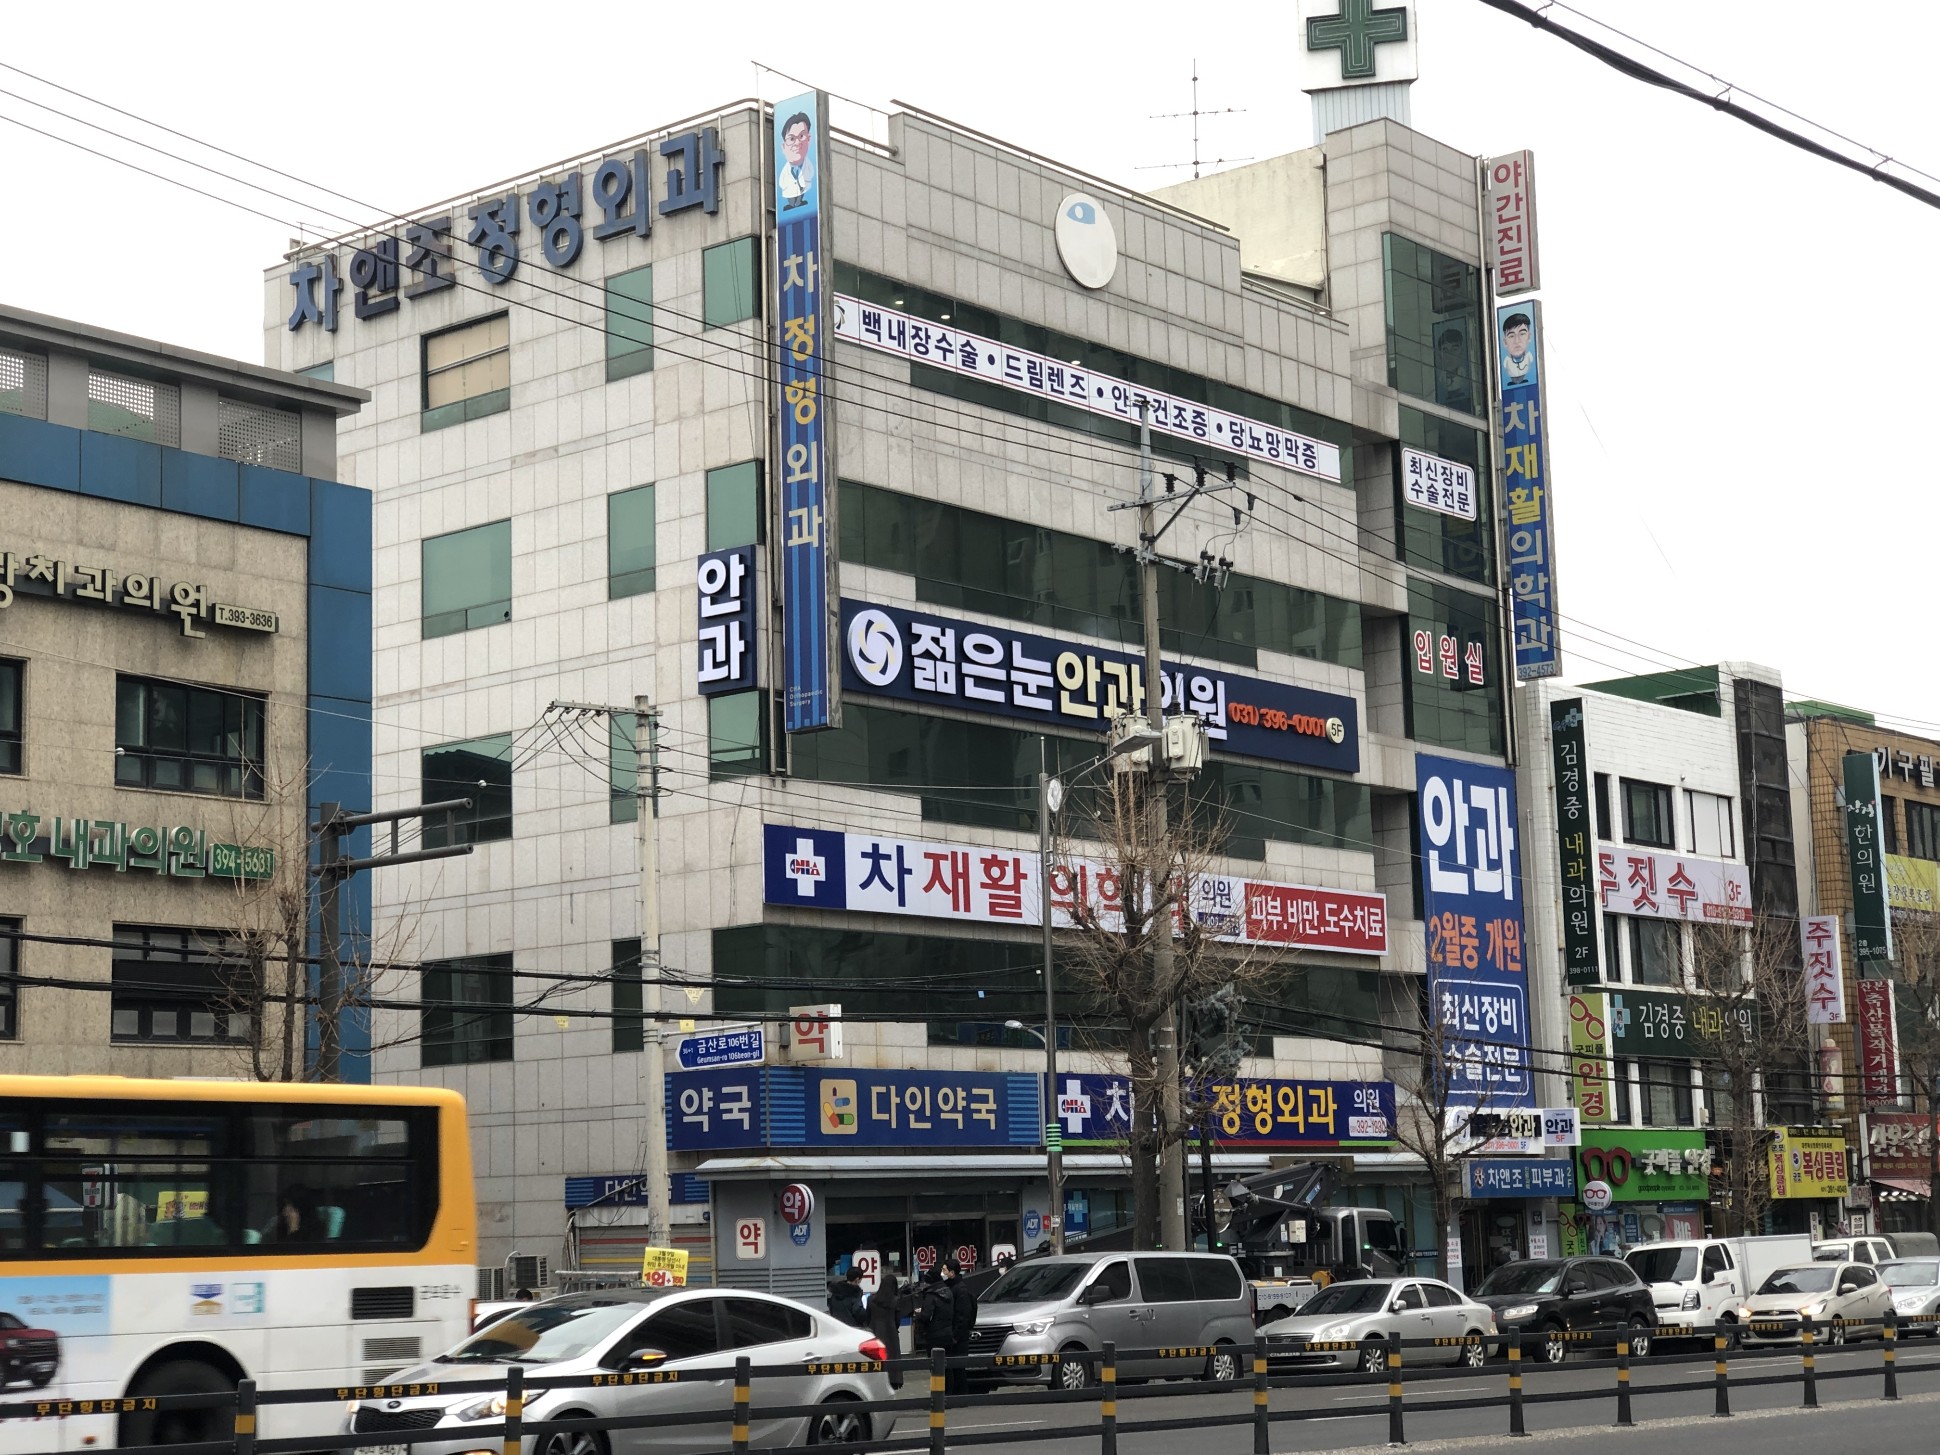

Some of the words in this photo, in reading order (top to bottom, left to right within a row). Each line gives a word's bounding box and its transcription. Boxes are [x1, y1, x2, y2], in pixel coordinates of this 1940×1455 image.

[1494, 160, 1525, 289] 야간진료
[783, 249, 824, 548] 차정형외과
[1003, 352, 1088, 400] 드림렌즈
[1228, 420, 1318, 470] 당뇨망막증
[1409, 455, 1469, 492] 최신장비
[1410, 478, 1471, 513] 수술전문
[1502, 400, 1553, 654] 차재활의학과
[217, 606, 274, 630] T.393-3636
[697, 553, 745, 683] 안과
[1414, 629, 1484, 686] 입원실
[1517, 663, 1555, 679] 392-4573
[1330, 722, 1343, 738] 5F
[1560, 740, 1583, 820] 김경중
[1878, 747, 1940, 788] 기구필
[51, 816, 206, 878] 내과의원
[1423, 776, 1514, 901] 안과
[1854, 823, 1876, 895] 한의원
[1202, 879, 1232, 909] 의원
[1564, 831, 1589, 936] 내과의원
[1727, 879, 1742, 902] 3F
[1429, 911, 1479, 970] 2월중
[1485, 918, 1522, 972] 개원
[1575, 947, 1589, 959] 2F
[1806, 920, 1836, 1012] 주짓수
[1829, 1012, 1841, 1022] 3F
[1441, 992, 1518, 1034] 최신장비
[1639, 1003, 1687, 1040] 김경중
[795, 1010, 829, 1053] 약
[697, 1055, 728, 1065] Geumsan-ro
[728, 1049, 760, 1062] 106beon-gil
[1575, 1043, 1604, 1054] 굿피플
[1578, 1061, 1605, 1117] 안경
[679, 1085, 751, 1133] 약국
[870, 1086, 997, 1131] 다인약국
[1212, 1084, 1338, 1136] 정형외과
[1353, 1088, 1381, 1113] 의원
[1545, 1119, 1573, 1134] 안과
[1555, 1134, 1566, 1143] 5F
[1488, 1168, 1523, 1189] 차앤조
[1531, 1168, 1565, 1188] 피부과
[1802, 1150, 1846, 1181] 복싱클럽
[783, 1191, 802, 1220] 약
[740, 1222, 761, 1254] 약
[793, 1227, 807, 1237] ADT
[1026, 1218, 1038, 1228] ADT
[857, 1257, 878, 1285] 약
[995, 1354, 1060, 1366] 무단횡단금지
[1158, 1346, 1217, 1358] 무단횡단금지
[1304, 1341, 1358, 1352] 무단횡단금지
[592, 1371, 679, 1385] 무단횡단금지
[807, 1361, 885, 1374] 무단횡단금지
[37, 1397, 157, 1415] 무단횡단금지
[336, 1383, 439, 1400] 무단횡단금지
